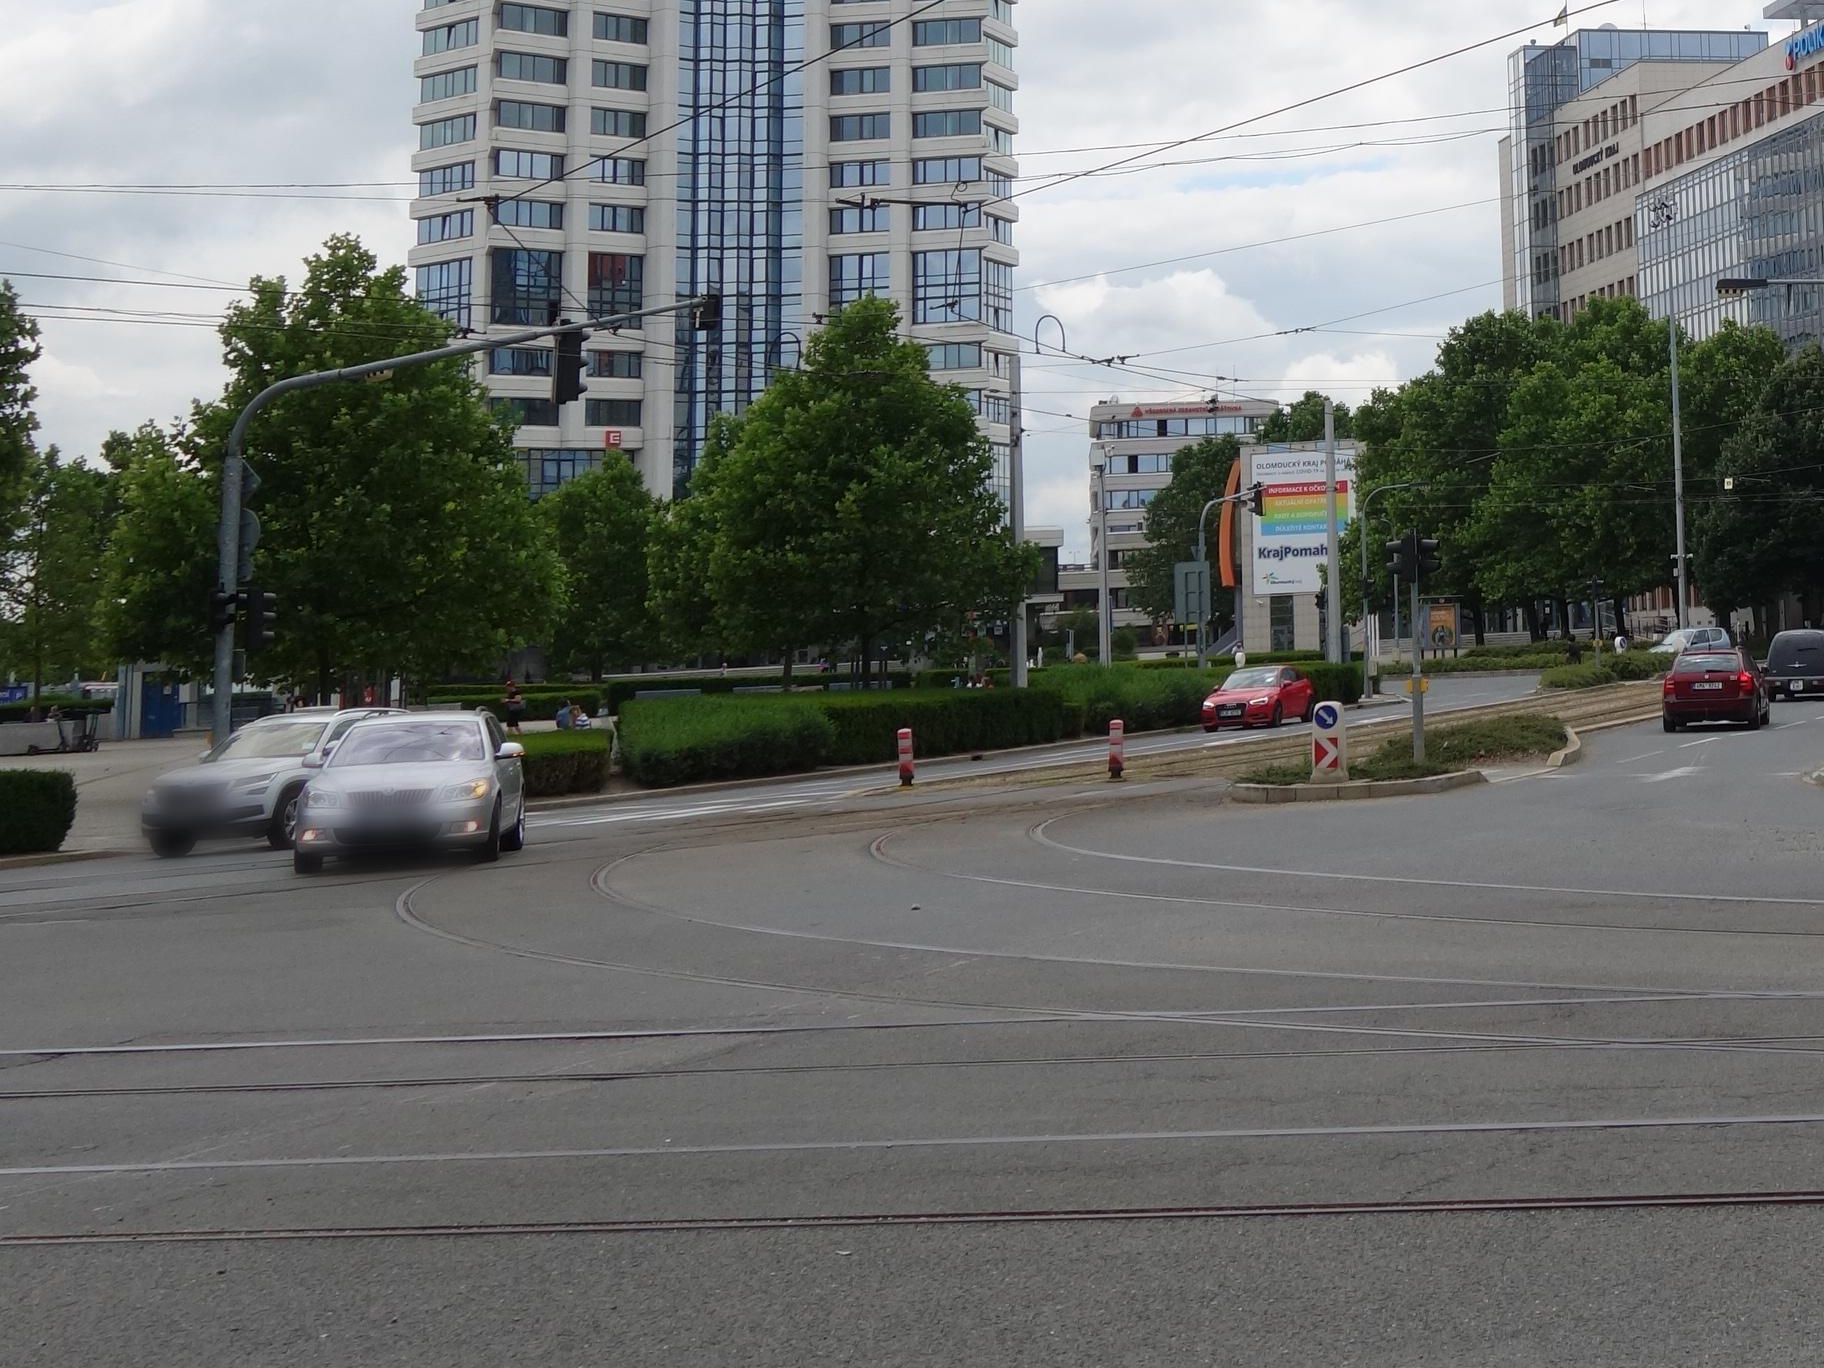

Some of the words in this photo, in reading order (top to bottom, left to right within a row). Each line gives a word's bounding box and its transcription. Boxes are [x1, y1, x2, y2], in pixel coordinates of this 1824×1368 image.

[1256, 460, 1301, 470] OLOMOUCKÝ
[1302, 459, 1319, 469] KRAJ
[1268, 485, 1303, 494] INFORMACE
[1258, 544, 1329, 561] KrajPomah
